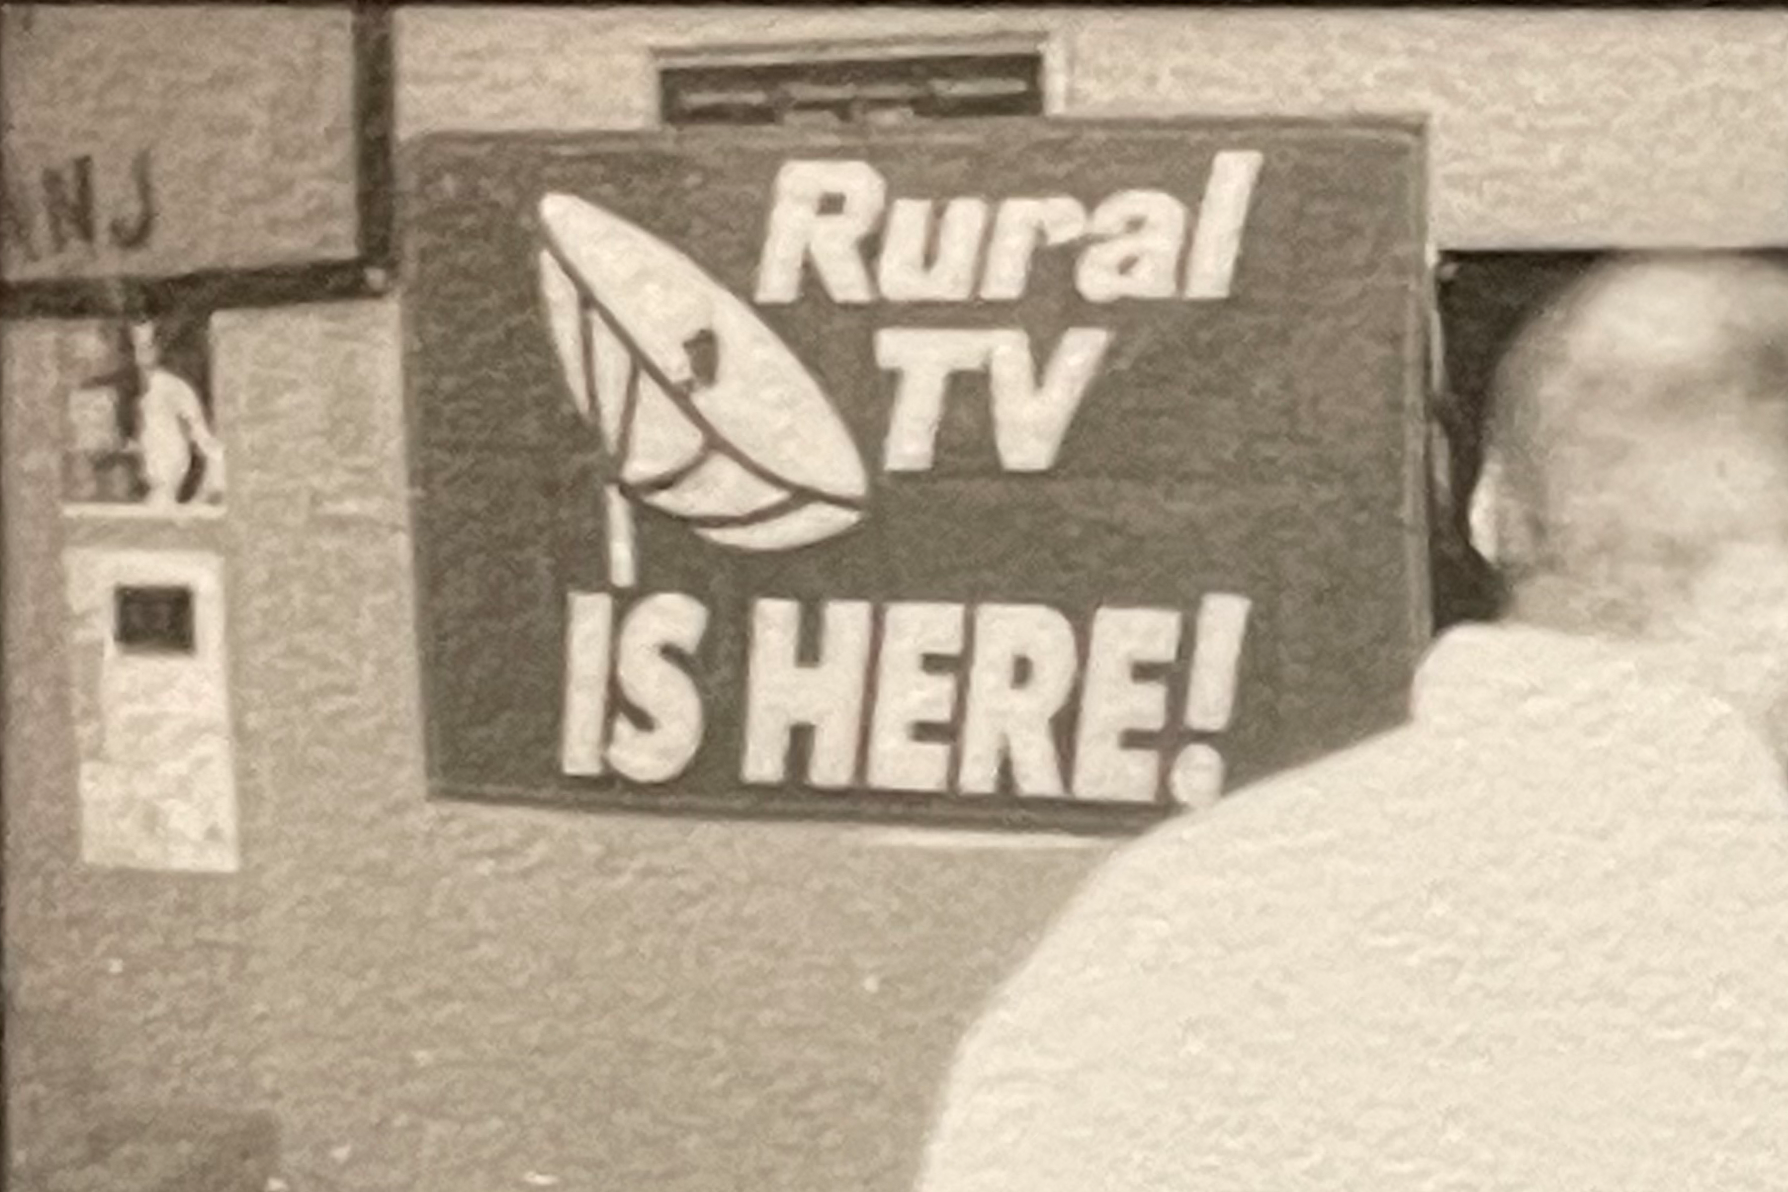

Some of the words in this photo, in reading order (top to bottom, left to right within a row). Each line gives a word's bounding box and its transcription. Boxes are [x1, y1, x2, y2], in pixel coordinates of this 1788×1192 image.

[753, 149, 1264, 305] Rural
[874, 325, 1111, 472] TV
[560, 590, 709, 783] IS
[740, 592, 1252, 808] HERE!
